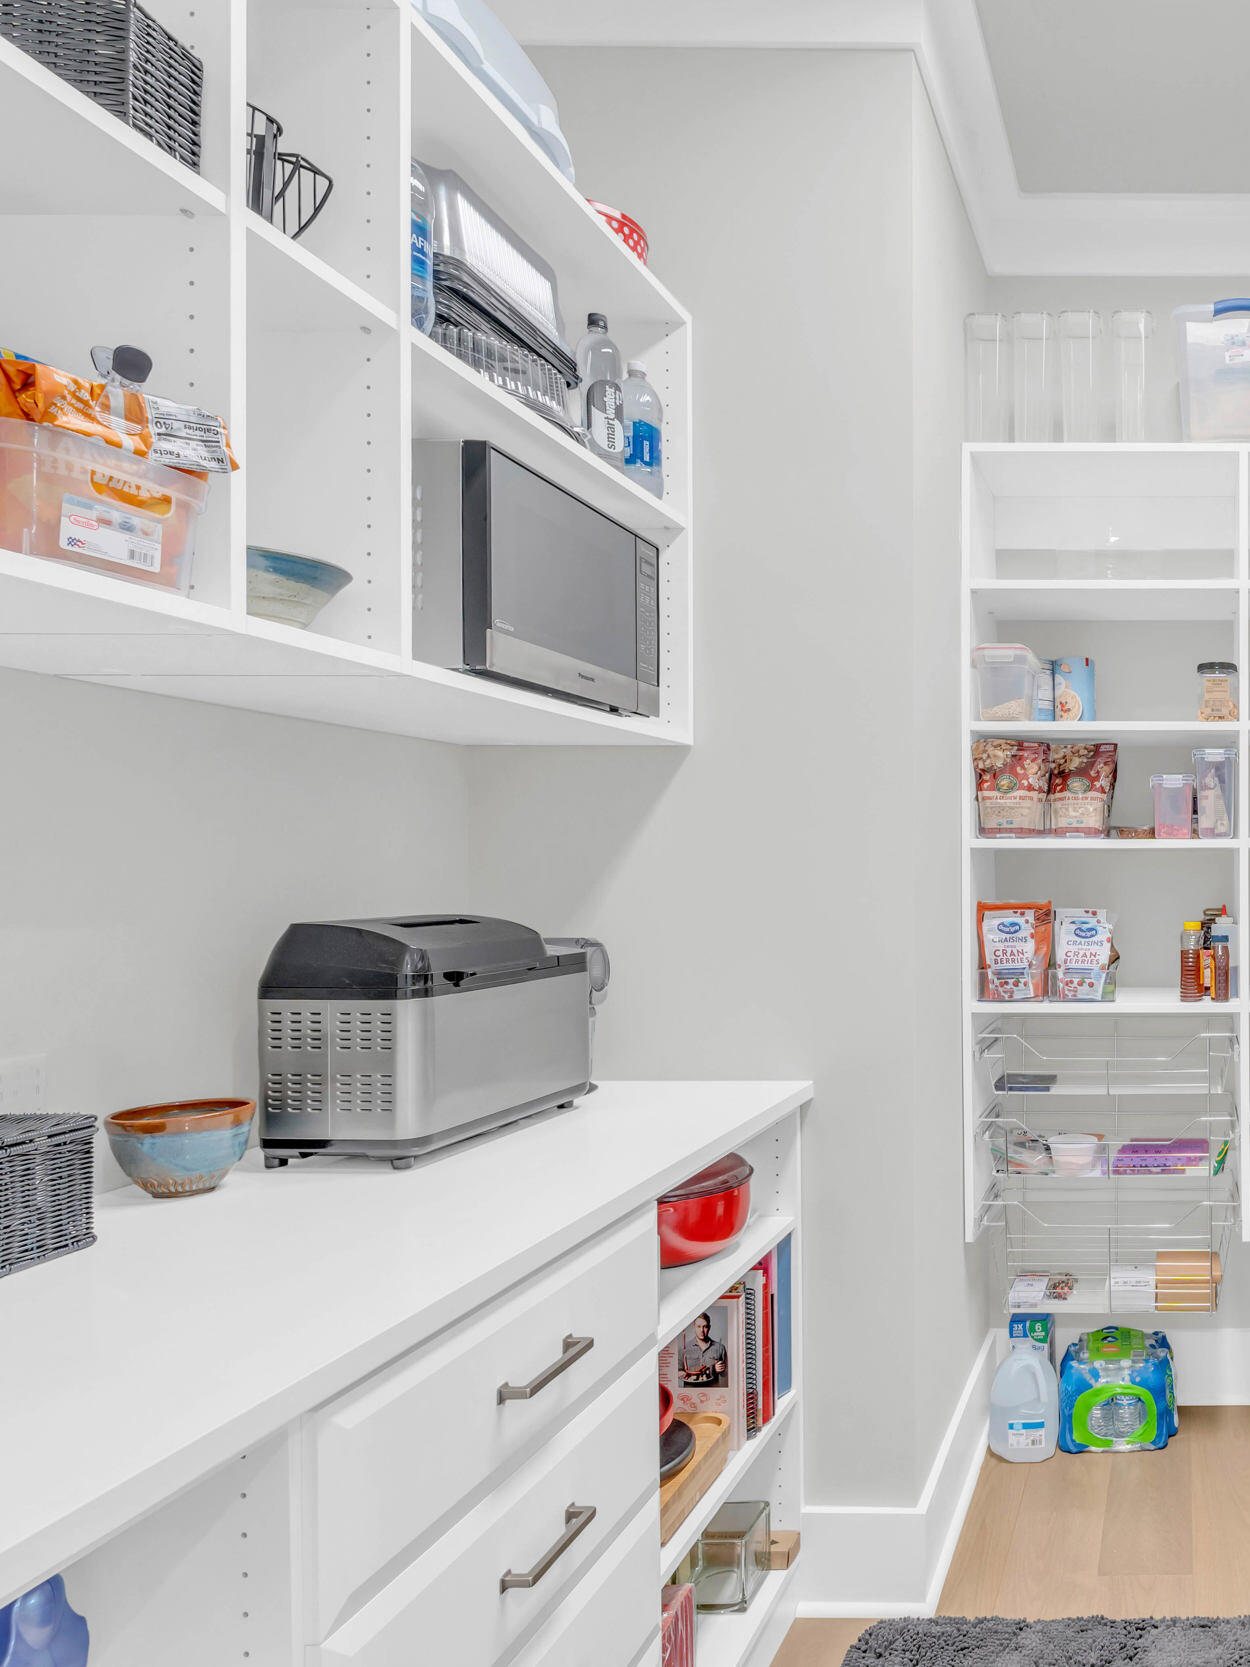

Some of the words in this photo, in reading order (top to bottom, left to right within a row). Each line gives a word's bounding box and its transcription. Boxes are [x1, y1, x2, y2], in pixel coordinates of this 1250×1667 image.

[603, 384, 617, 451] smartwater
[183, 423, 219, 437] Calories
[153, 448, 182, 459] Facts
[992, 935, 1029, 944] CRAISINS
[1066, 939, 1105, 947] CRAISINS
[993, 948, 1029, 958] CRAN-
[1064, 950, 1101, 959] CRAN-
[993, 956, 1030, 965] BERRIES
[1063, 957, 1101, 965] BERRIES
[1012, 1323, 1024, 1332] 3X
[1035, 1322, 1043, 1332] 6
